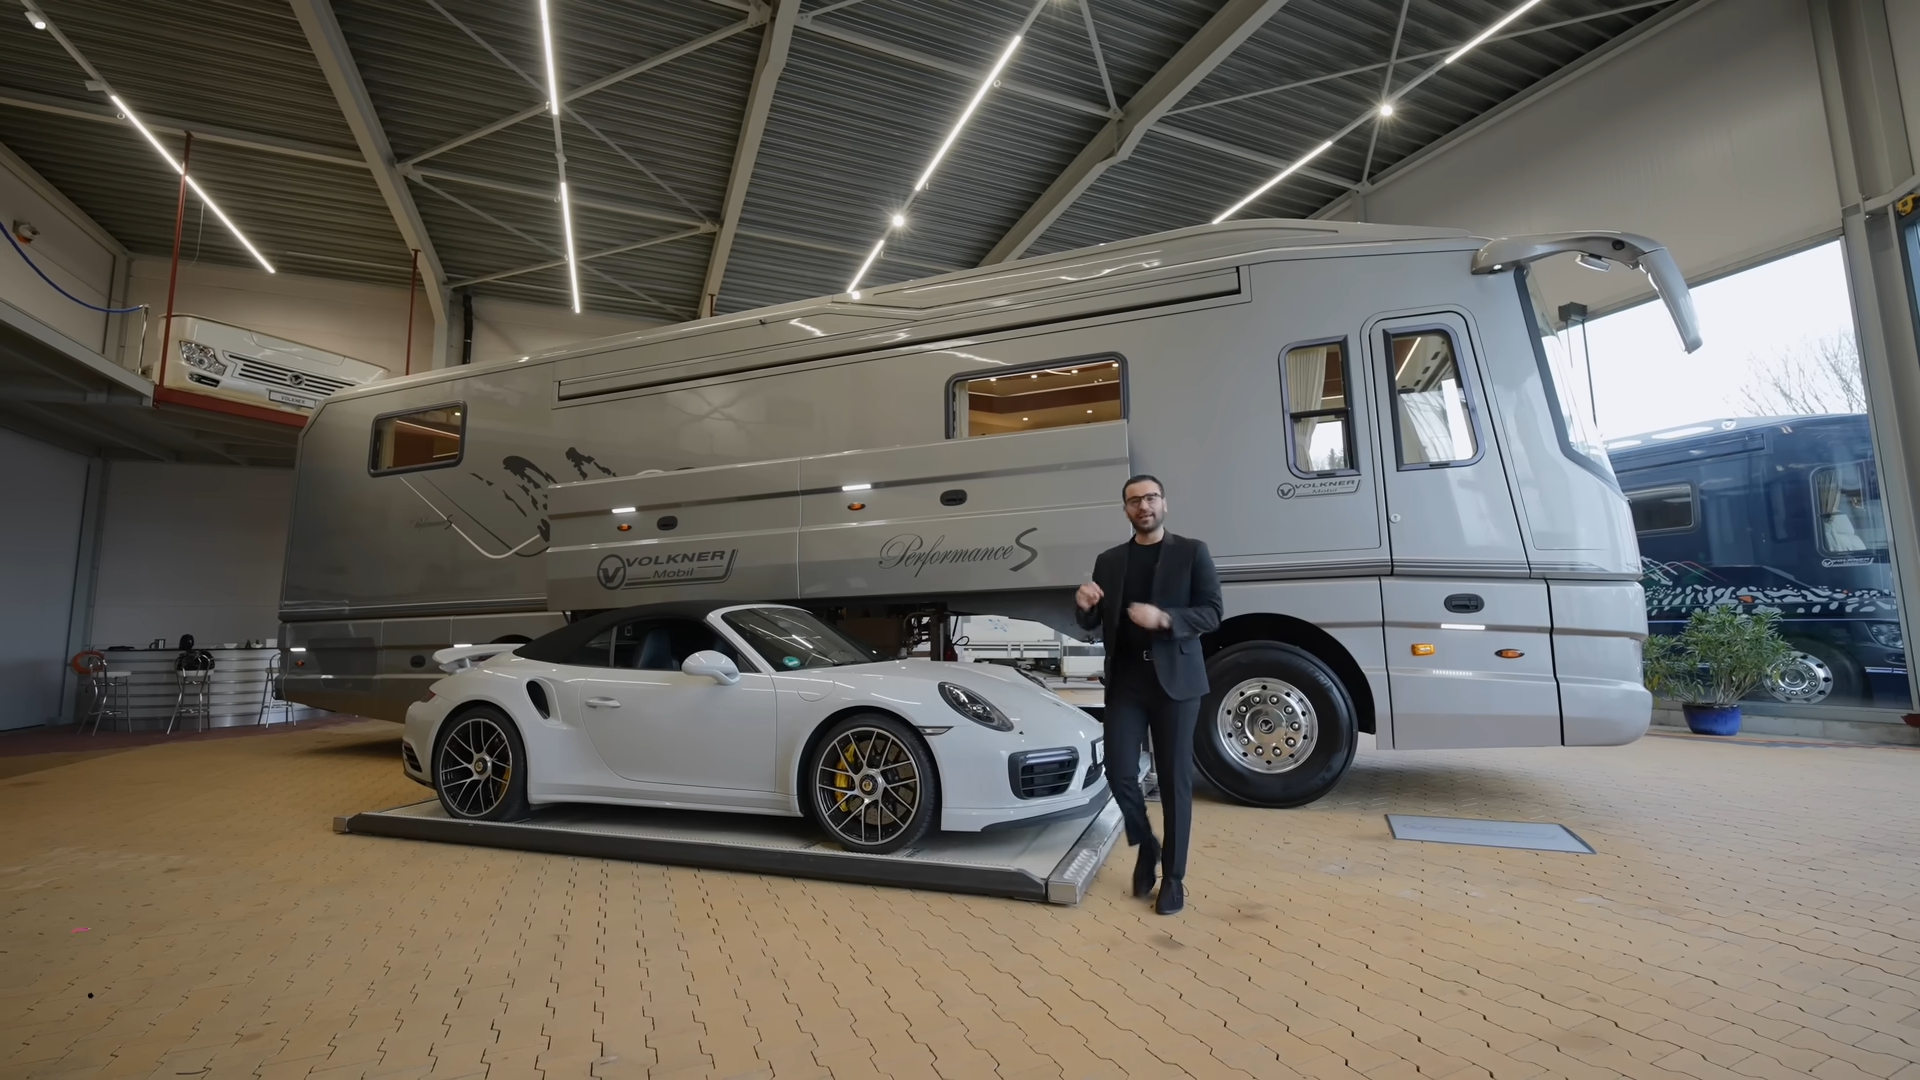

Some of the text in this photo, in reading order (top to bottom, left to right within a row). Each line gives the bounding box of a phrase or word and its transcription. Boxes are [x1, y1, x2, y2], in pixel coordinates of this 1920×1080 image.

[281, 396, 306, 404] VOLKNER
[1294, 480, 1355, 489] VOLKNER
[878, 527, 1038, 578] Performance S
[626, 550, 726, 568] VOLKNER
[652, 568, 694, 579] Mobil
